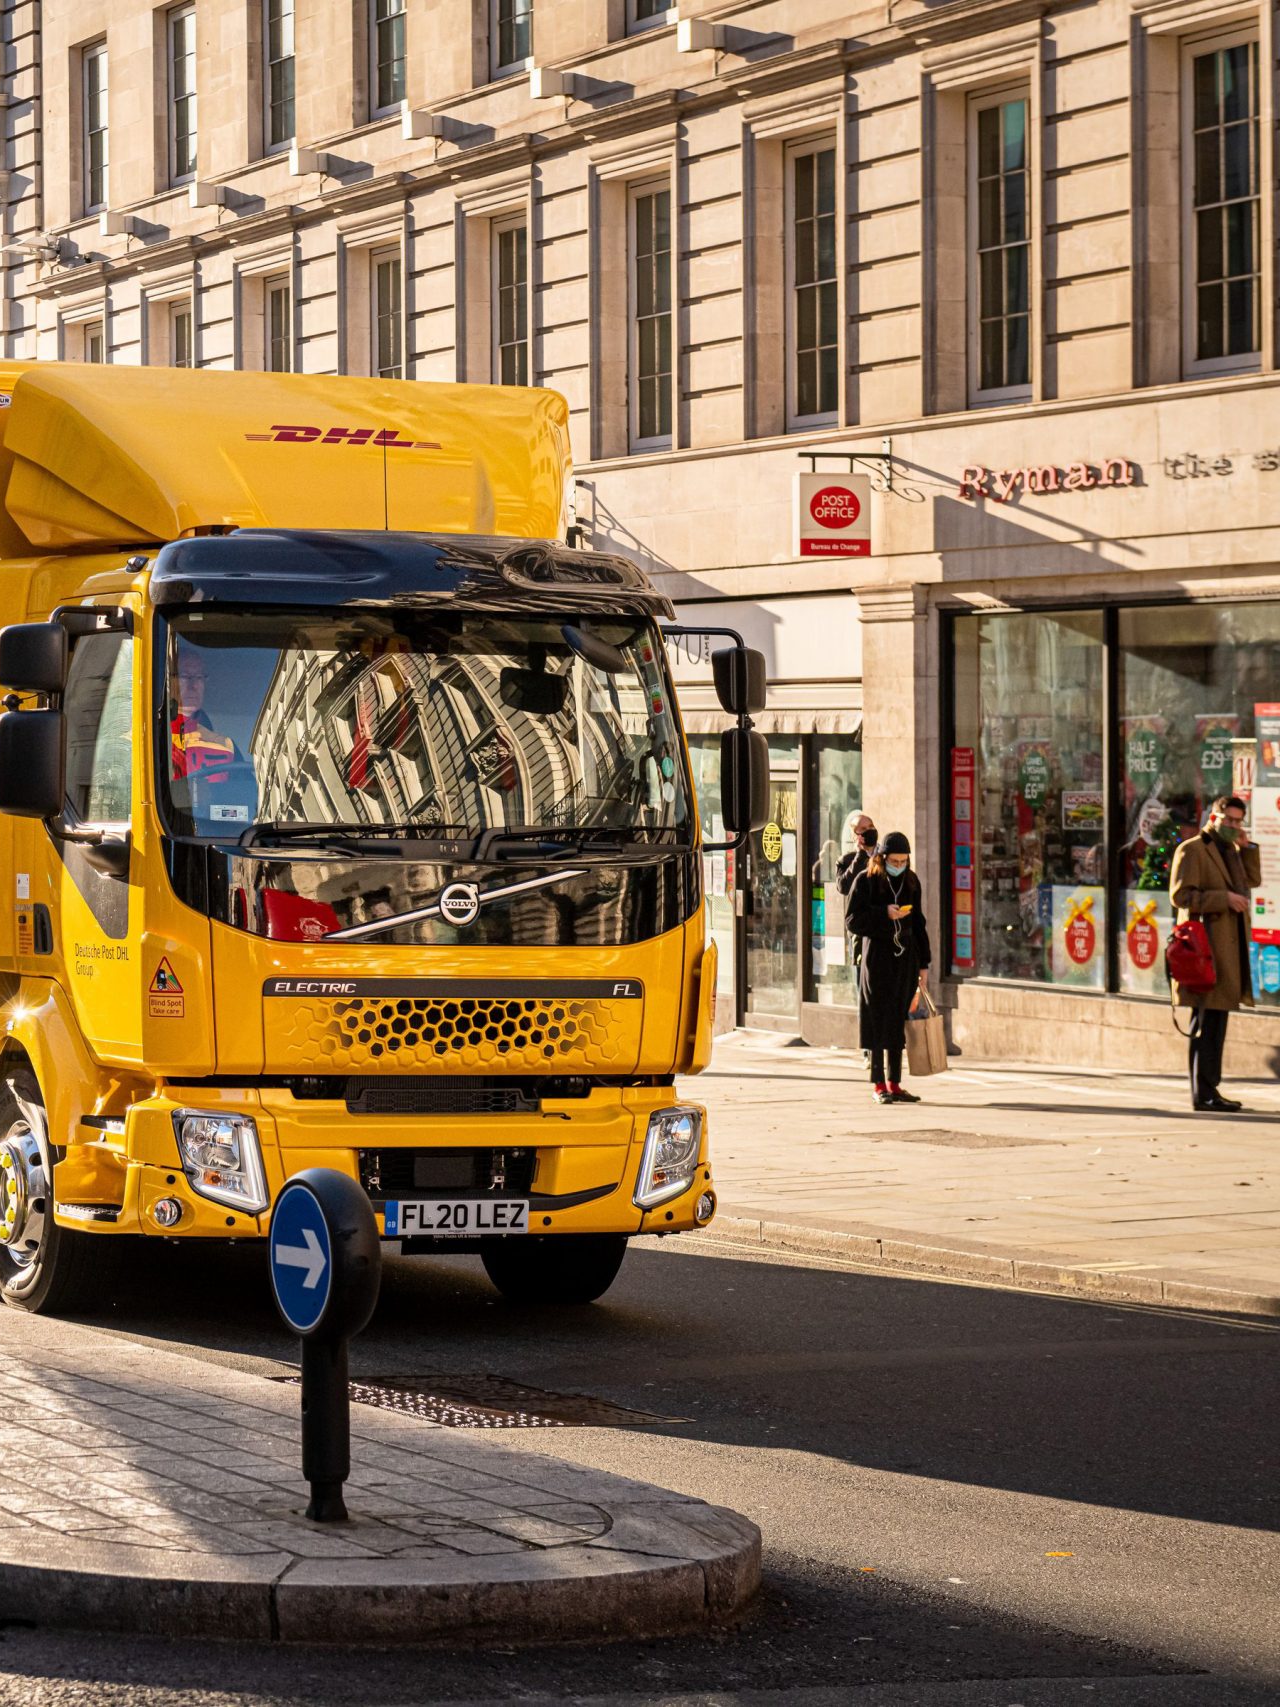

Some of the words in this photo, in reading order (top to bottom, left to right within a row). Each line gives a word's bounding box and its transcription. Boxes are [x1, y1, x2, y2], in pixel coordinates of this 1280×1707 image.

[271, 425, 414, 448] DHL
[958, 456, 1134, 503] Ryman
[1164, 452, 1234, 480] the
[821, 494, 851, 506] POST
[814, 507, 855, 519] OFFICE
[810, 542, 831, 550] Bureau
[840, 543, 860, 551] Change
[1128, 740, 1156, 756] HALF
[1128, 757, 1158, 773] PRICE
[442, 900, 477, 908] VOLVO
[75, 943, 100, 959] Deutsche
[102, 945, 115, 960] Post
[117, 946, 130, 961] DHL
[75, 961, 94, 981] Group
[274, 982, 357, 993] ELECTRIC
[612, 983, 636, 996] FL
[401, 1204, 469, 1229] FL20
[476, 1203, 525, 1228] LEZ
